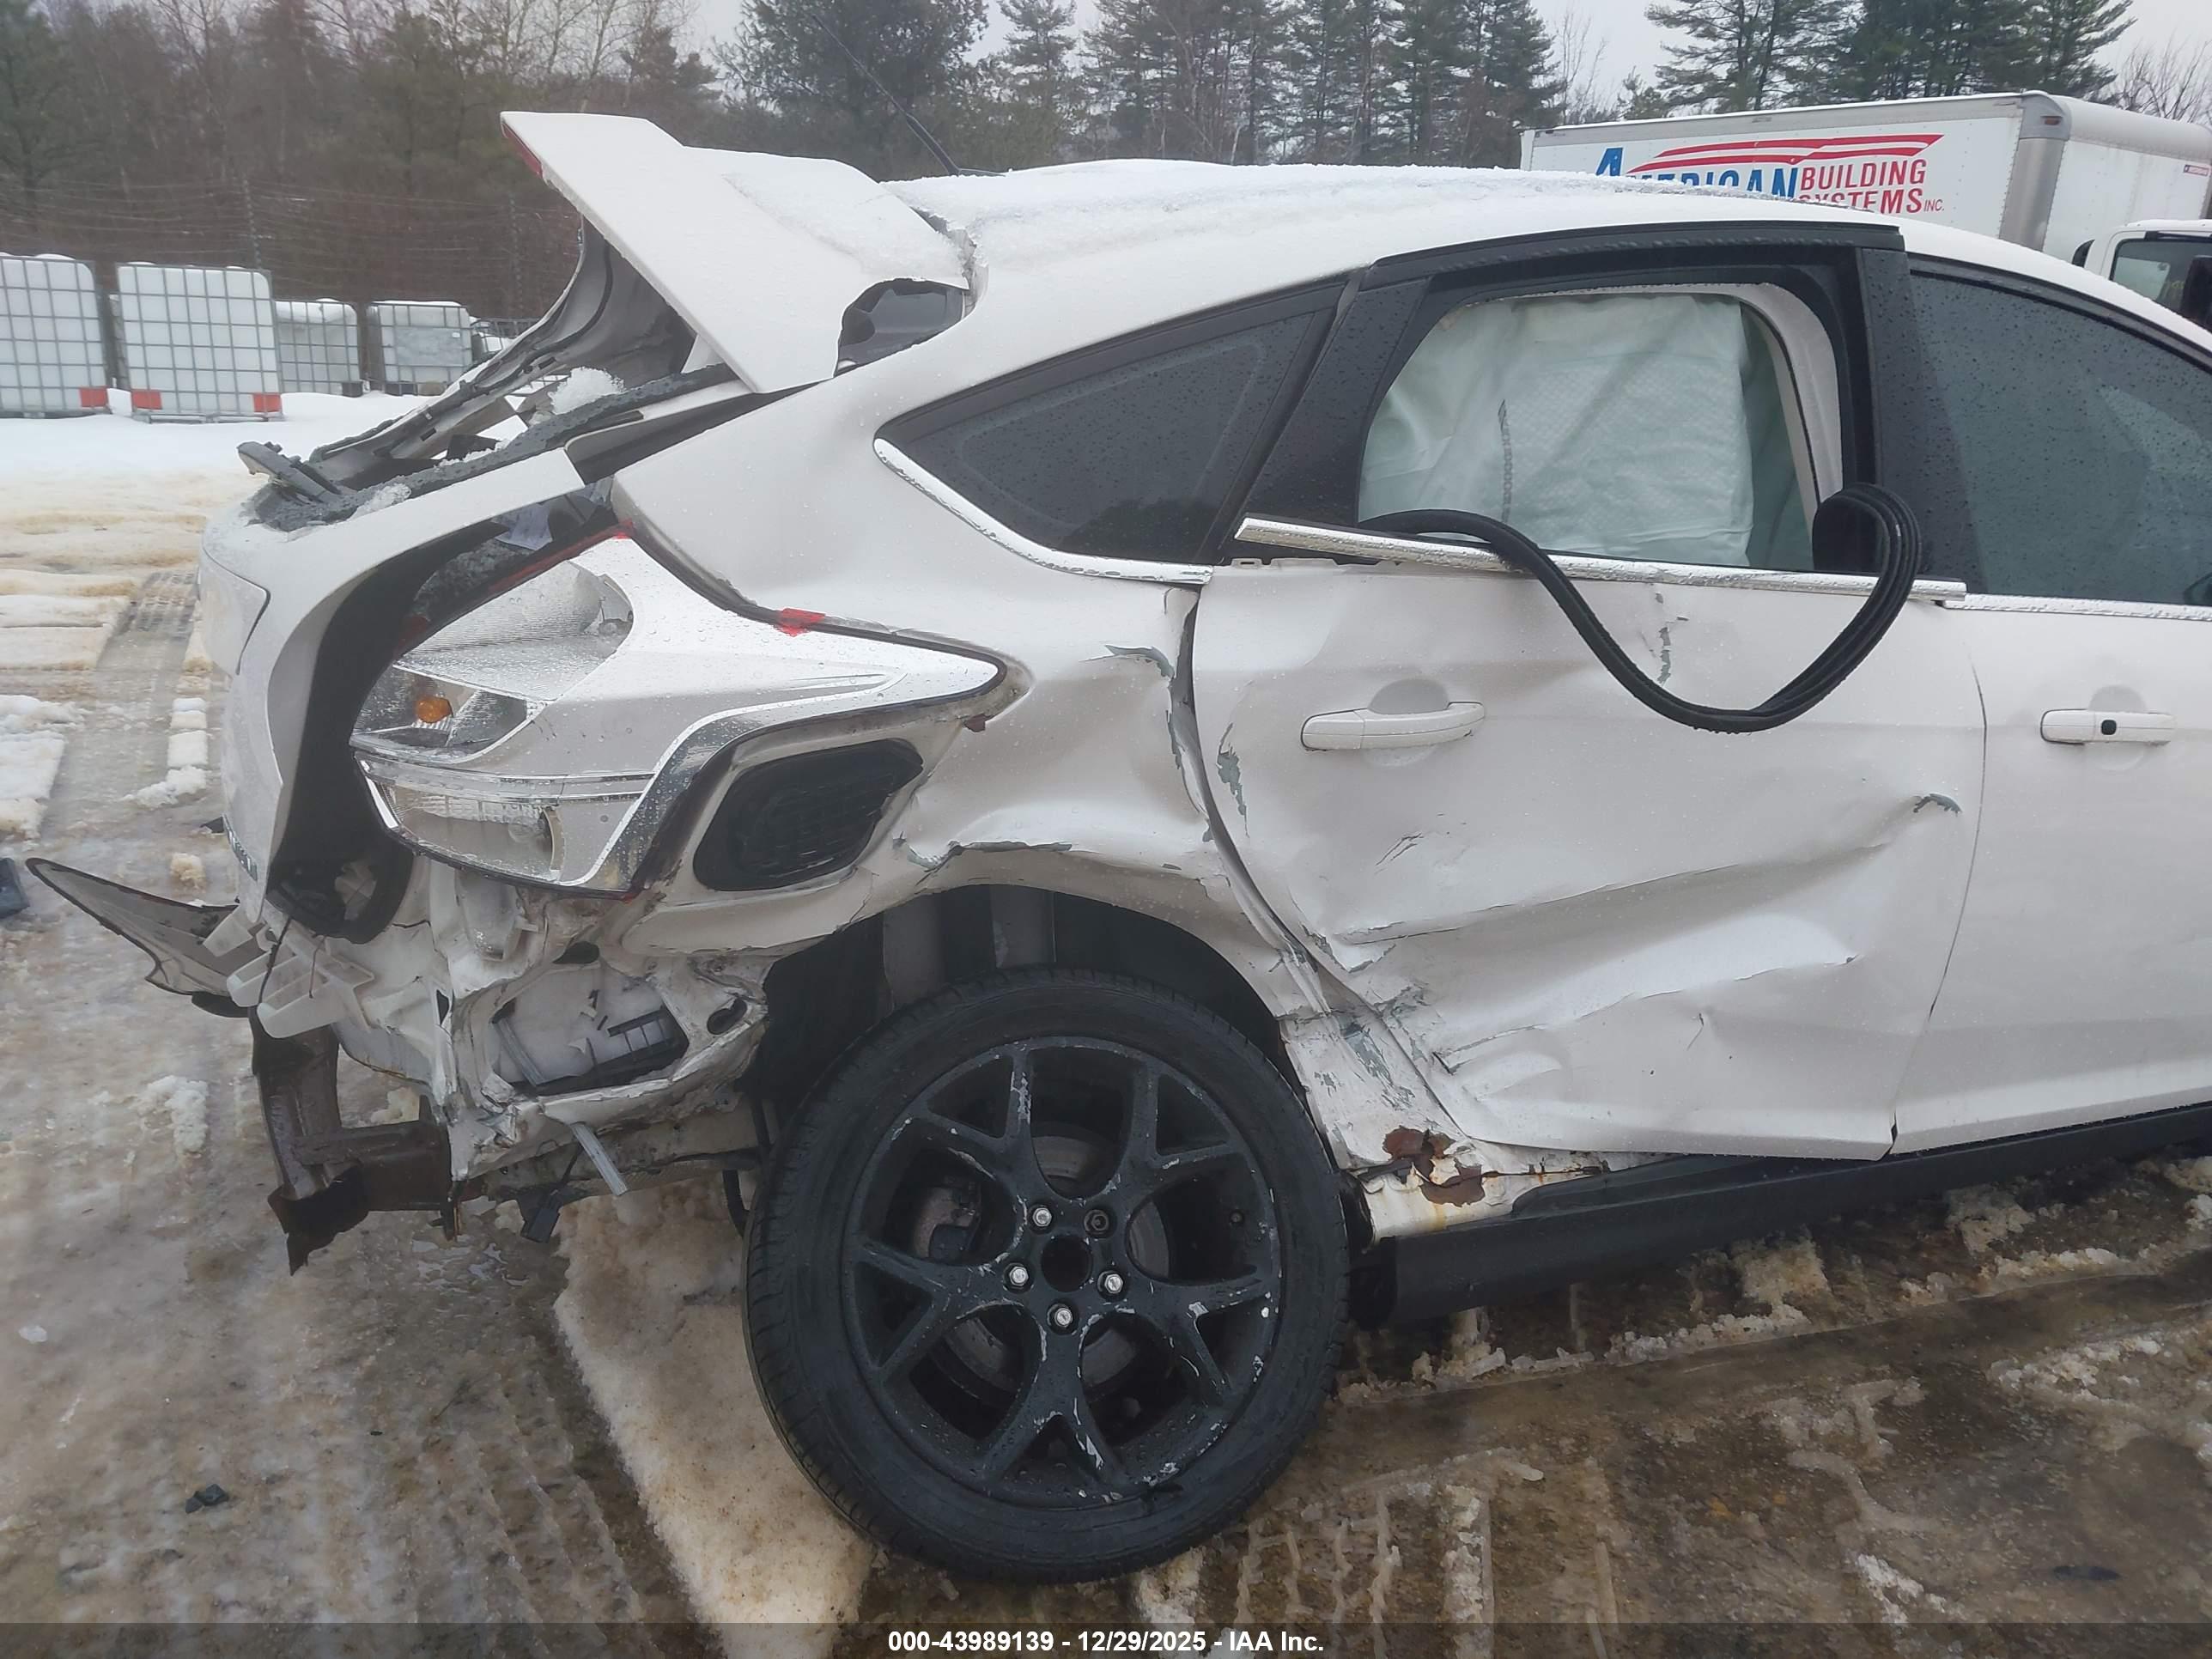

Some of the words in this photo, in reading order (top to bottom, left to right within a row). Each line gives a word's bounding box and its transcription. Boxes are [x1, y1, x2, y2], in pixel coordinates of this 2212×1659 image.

[1595, 147, 1799, 198] ACAN
[1801, 159, 1927, 191] BUILDING
[1798, 188, 1923, 214] TEMS
[1923, 198, 1945, 212] INC.
